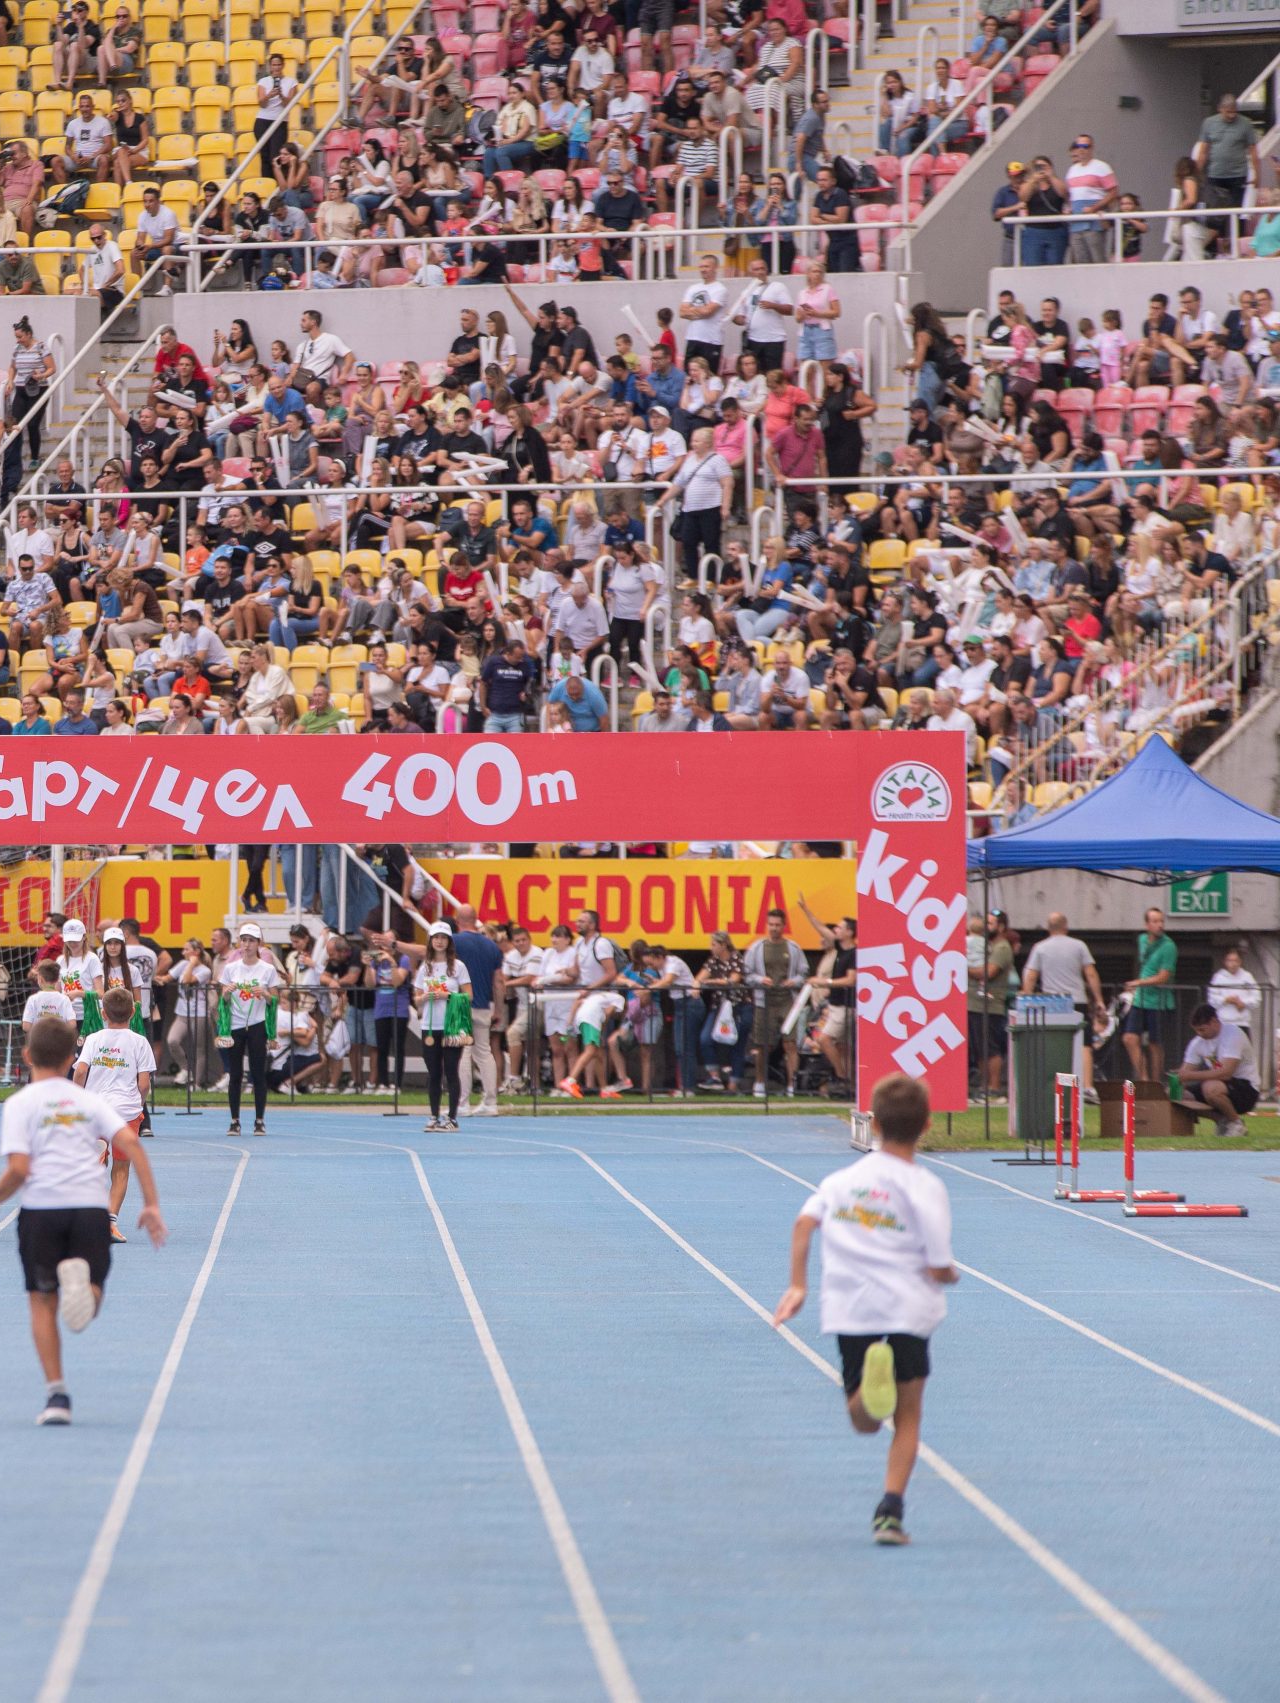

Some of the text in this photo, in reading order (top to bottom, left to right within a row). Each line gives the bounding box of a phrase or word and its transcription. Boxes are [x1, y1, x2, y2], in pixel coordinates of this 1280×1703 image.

[881, 768, 942, 809] VITALIA
[888, 812, 914, 820] Health
[124, 876, 200, 934] OF
[1176, 891, 1222, 912] EXIT
